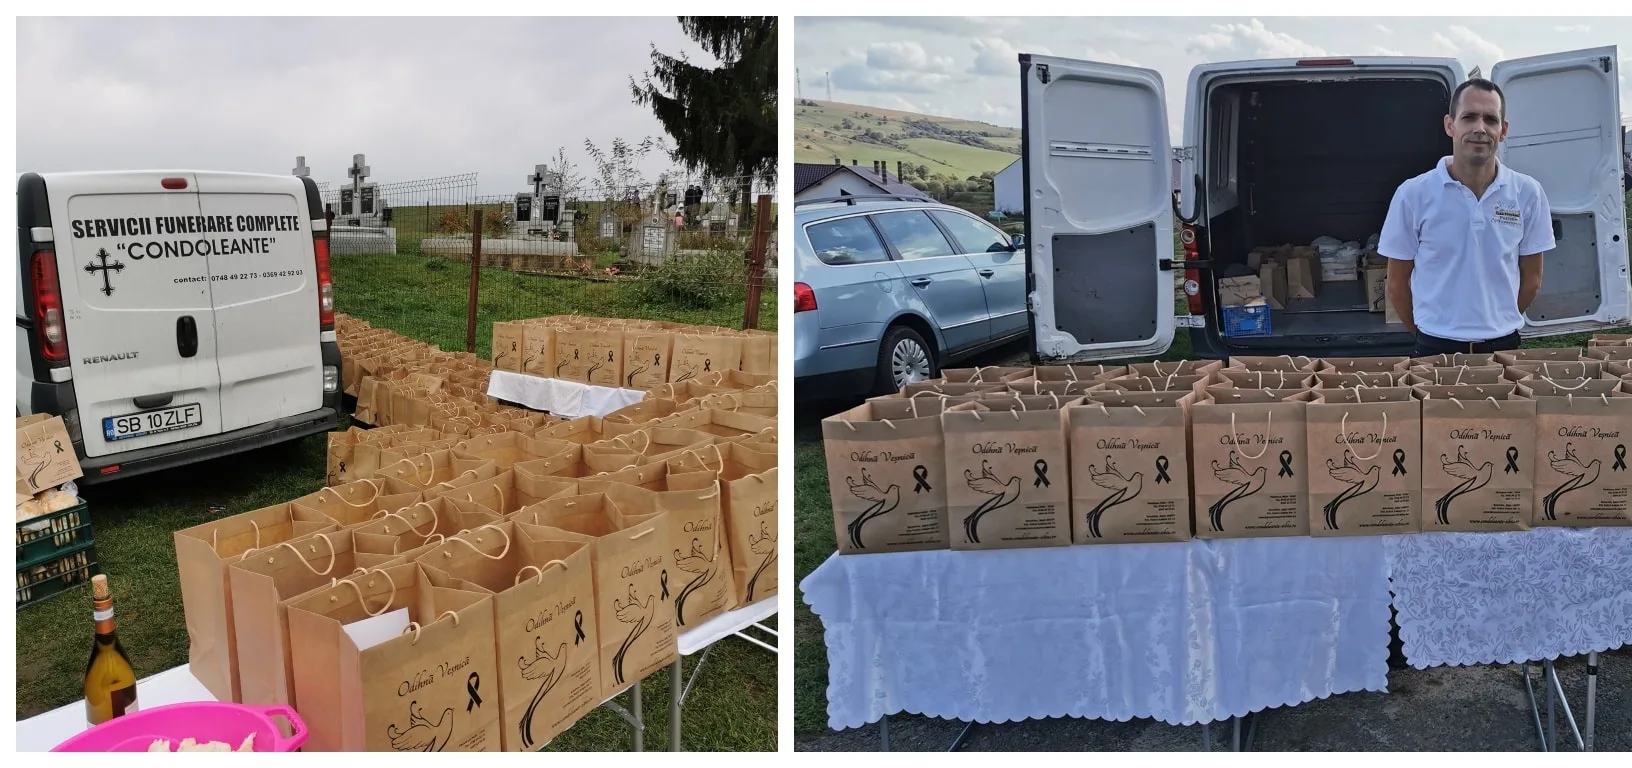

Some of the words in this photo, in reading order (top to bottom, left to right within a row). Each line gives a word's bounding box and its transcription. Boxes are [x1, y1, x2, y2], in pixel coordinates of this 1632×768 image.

[72, 216, 152, 239] SERVICII
[155, 215, 234, 235] FUNERARE
[236, 215, 300, 232] COMPLETE
[173, 275, 207, 284] contact:
[211, 274, 228, 282] 0748
[82, 351, 139, 365] RENAULT
[116, 416, 142, 434] SB
[146, 413, 162, 429] 10
[164, 407, 195, 426] ZLF
